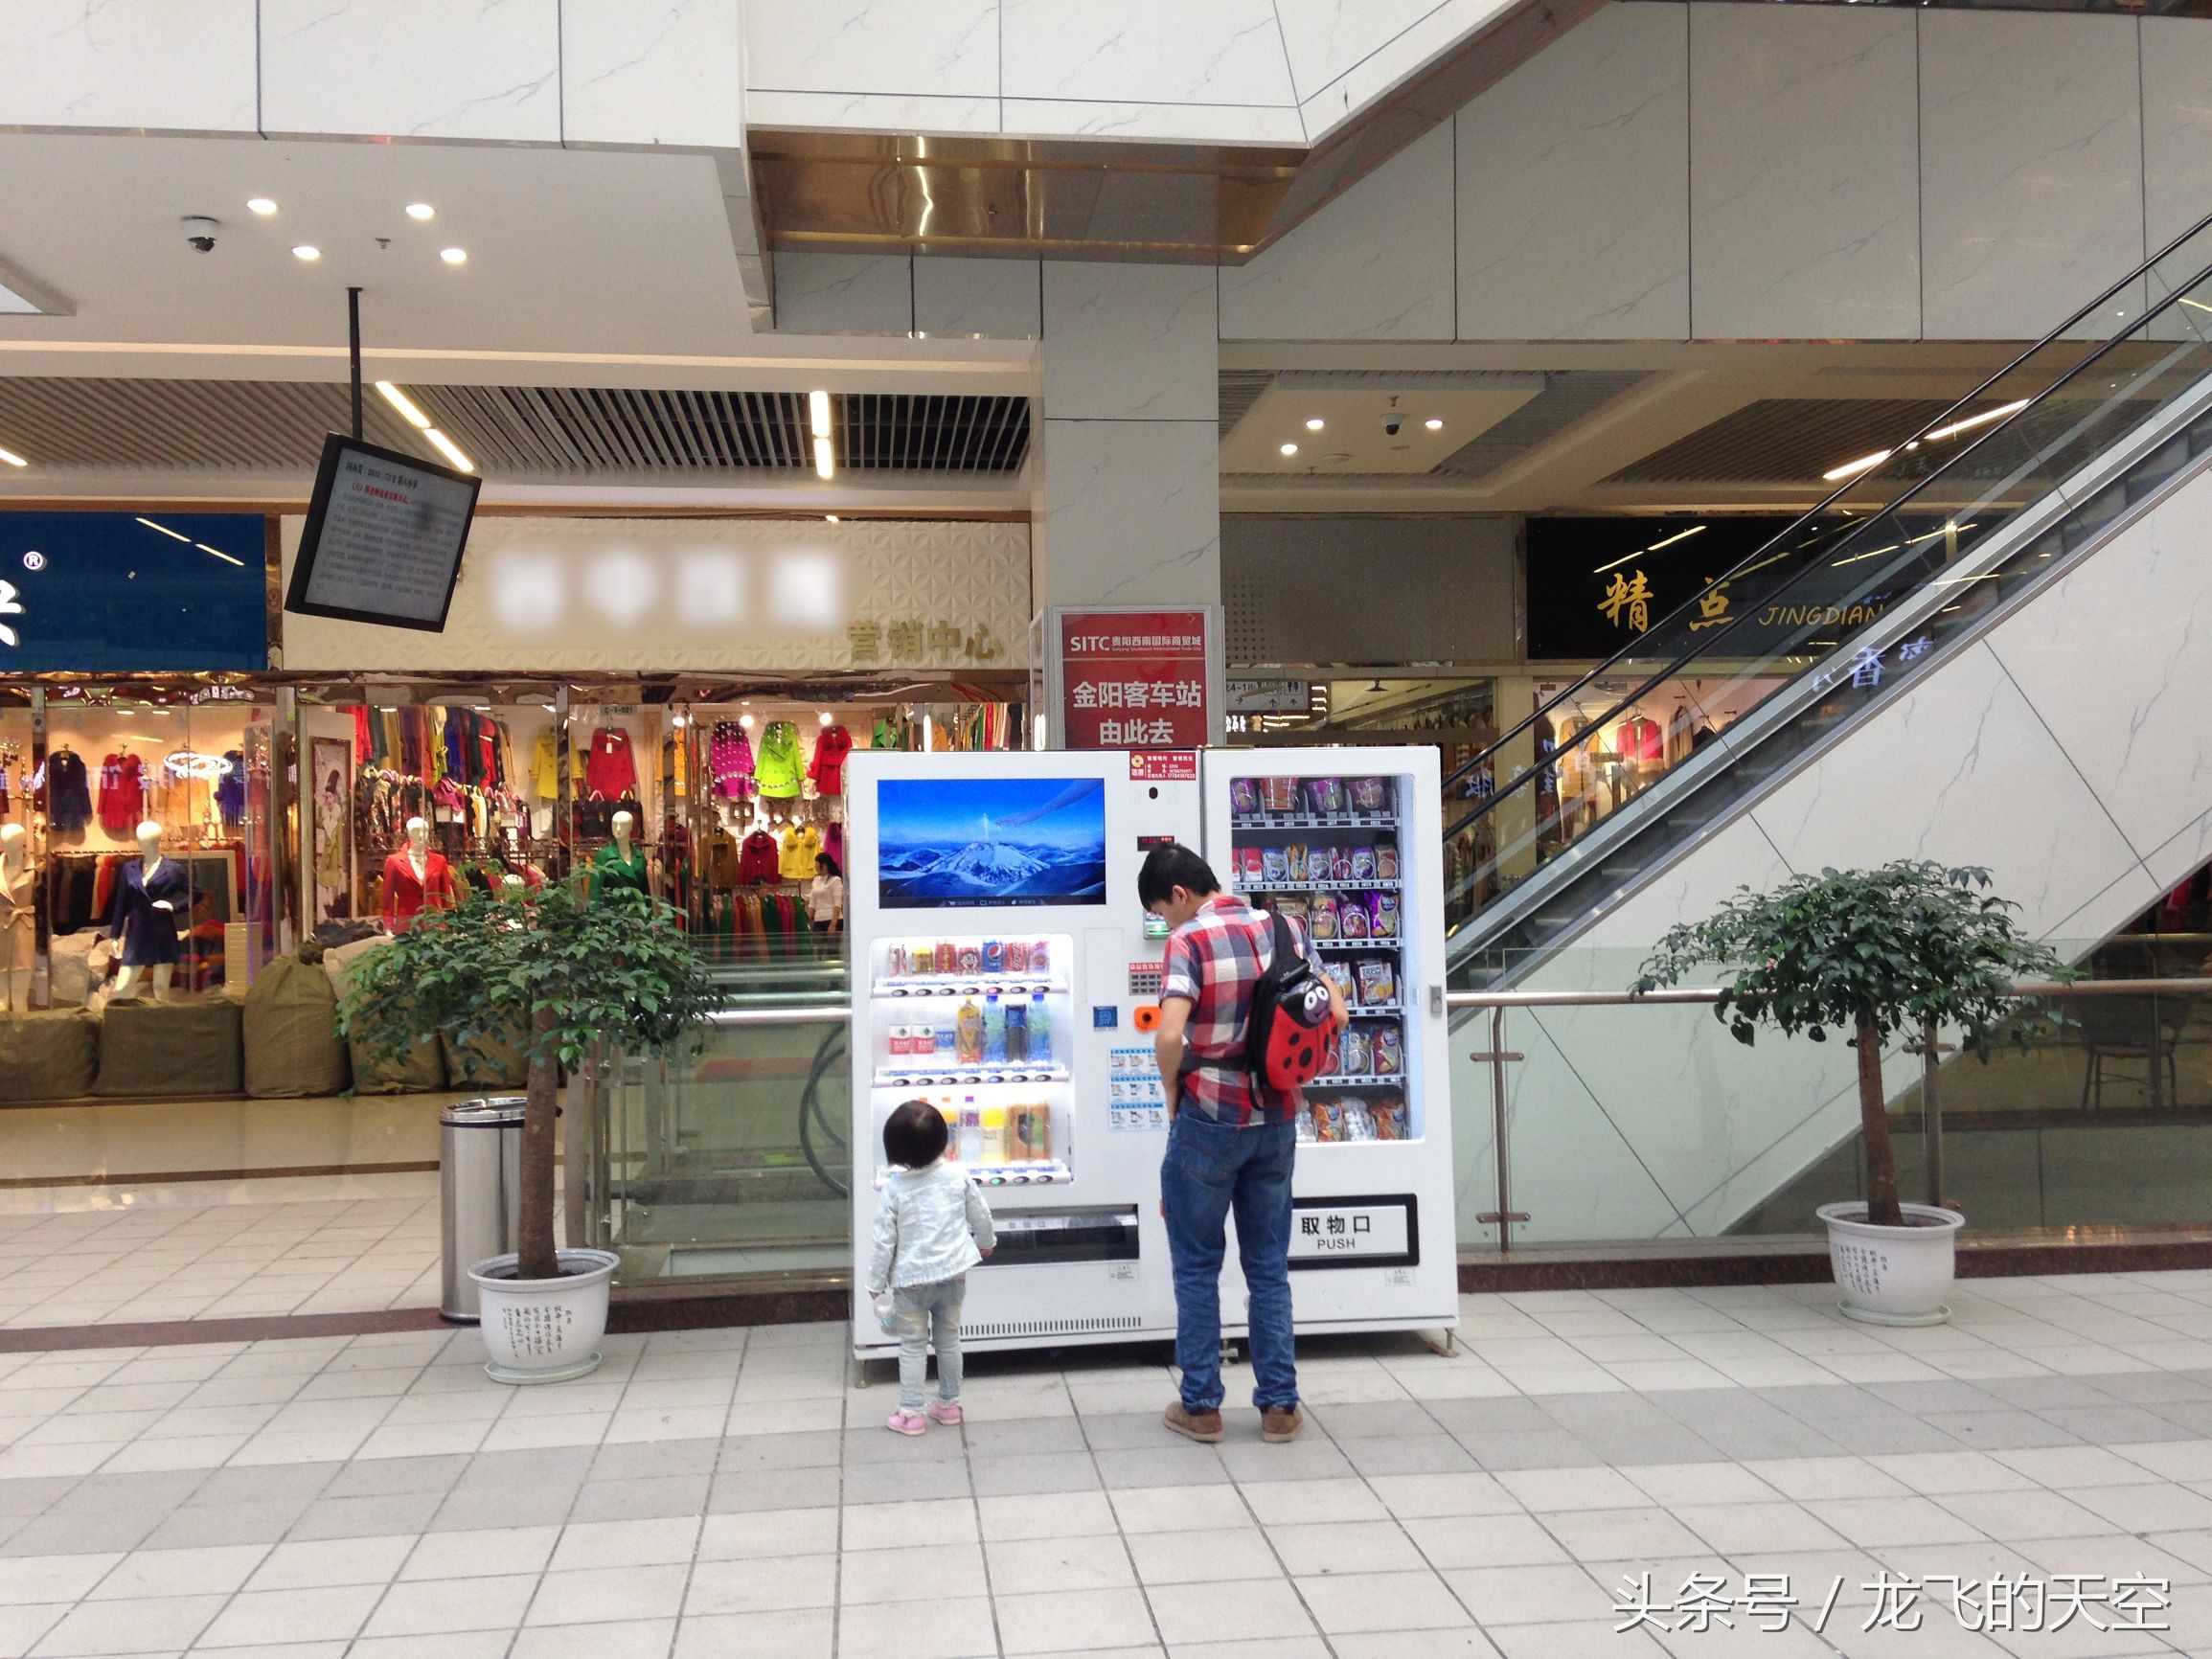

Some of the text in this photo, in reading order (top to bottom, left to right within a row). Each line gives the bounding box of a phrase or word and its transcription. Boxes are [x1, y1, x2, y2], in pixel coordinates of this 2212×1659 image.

[846, 619, 1004, 660] 营销中心
[1070, 636, 1110, 652] SITC
[1111, 635, 1201, 647] 贵阳西南国际商贸城
[1072, 680, 1201, 709] 金阳客车站
[604, 706, 633, 715] C-1-021
[1099, 718, 1174, 745] 由此去
[1301, 1214, 1371, 1236] 取物口
[1317, 1238, 1356, 1249] PUSH
